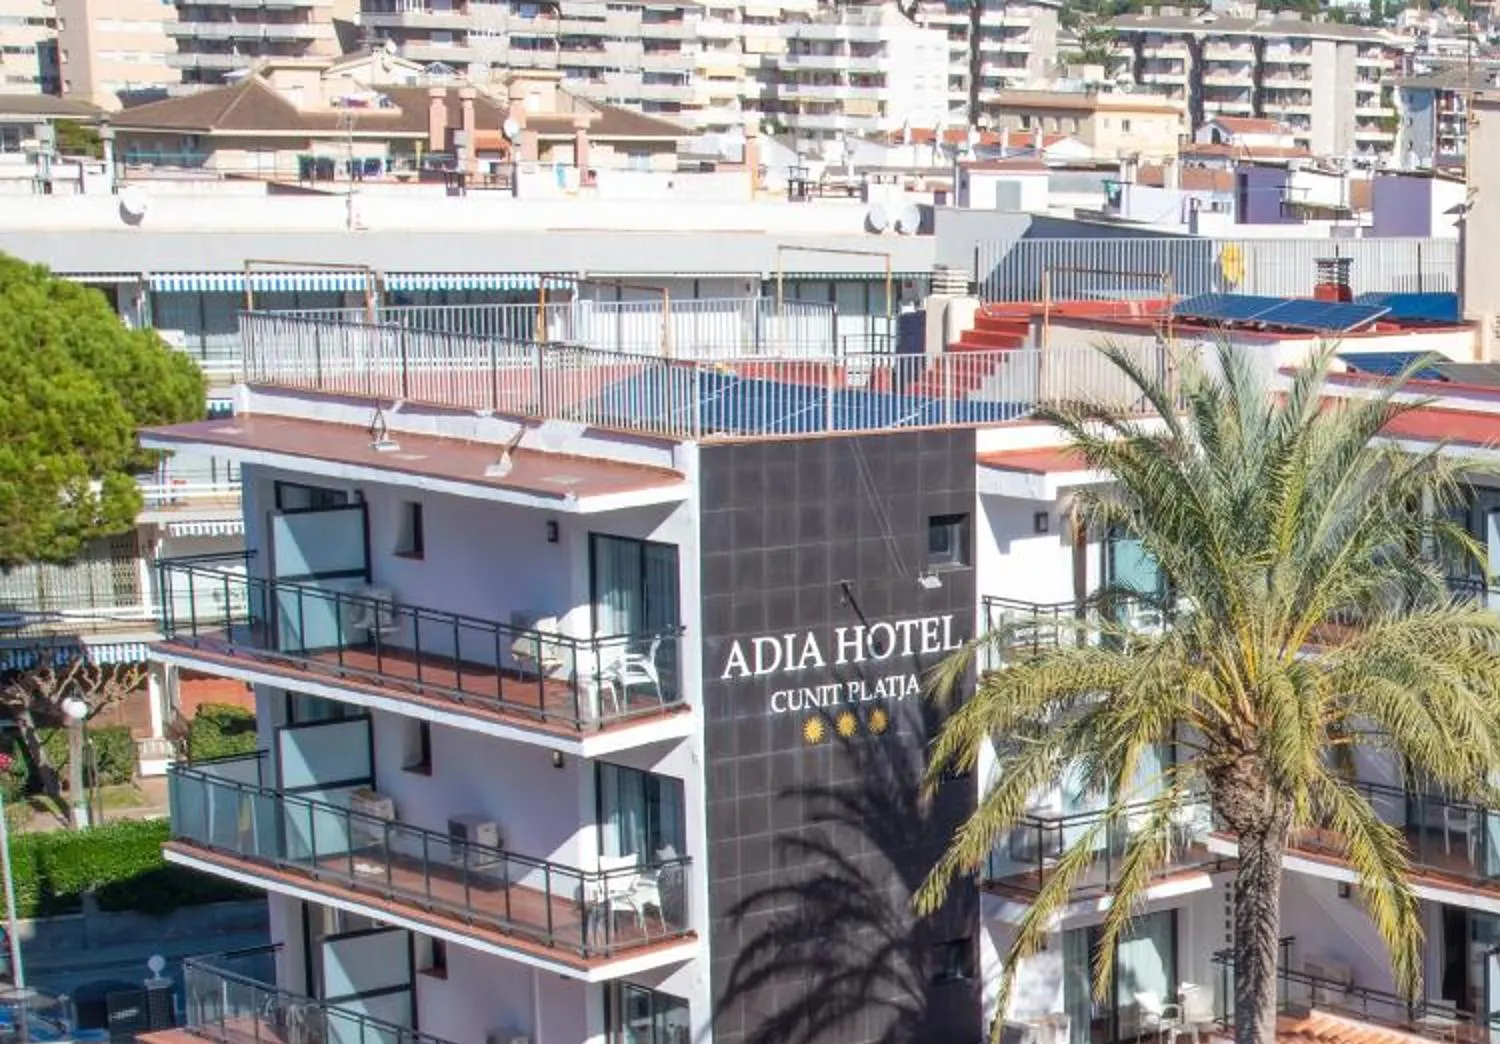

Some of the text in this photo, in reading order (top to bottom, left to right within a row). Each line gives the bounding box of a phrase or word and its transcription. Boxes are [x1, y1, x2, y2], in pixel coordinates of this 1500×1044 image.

[720, 615, 963, 679] ADIA HOTEL
[771, 674, 920, 713] CUNIT PLATJA
